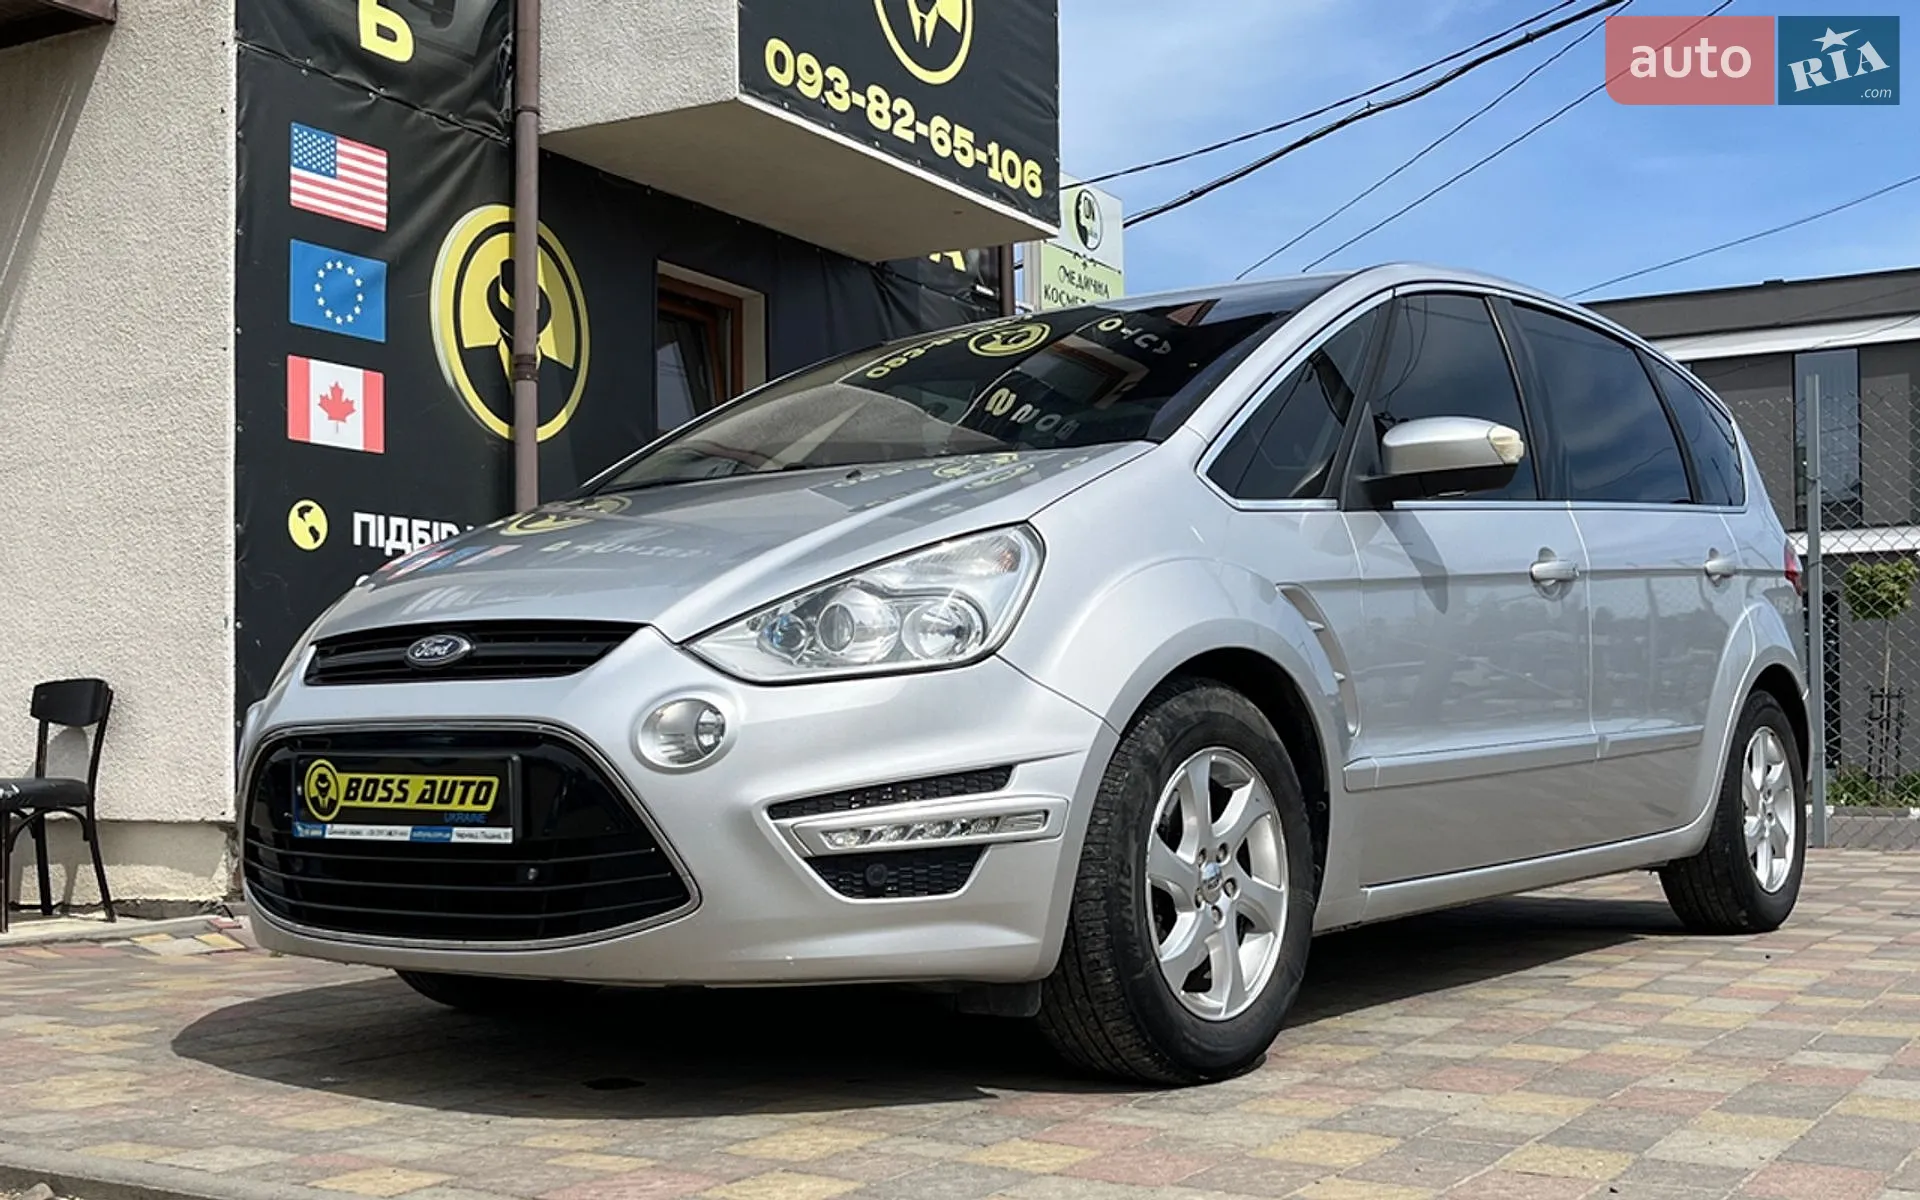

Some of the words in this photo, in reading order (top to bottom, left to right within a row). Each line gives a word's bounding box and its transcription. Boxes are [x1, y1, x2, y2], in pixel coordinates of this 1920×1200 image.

[765, 37, 1043, 199] 093-82-65-106
[414, 641, 454, 657] Ford
[343, 778, 410, 803] BOSS
[415, 779, 494, 806] AUTO
